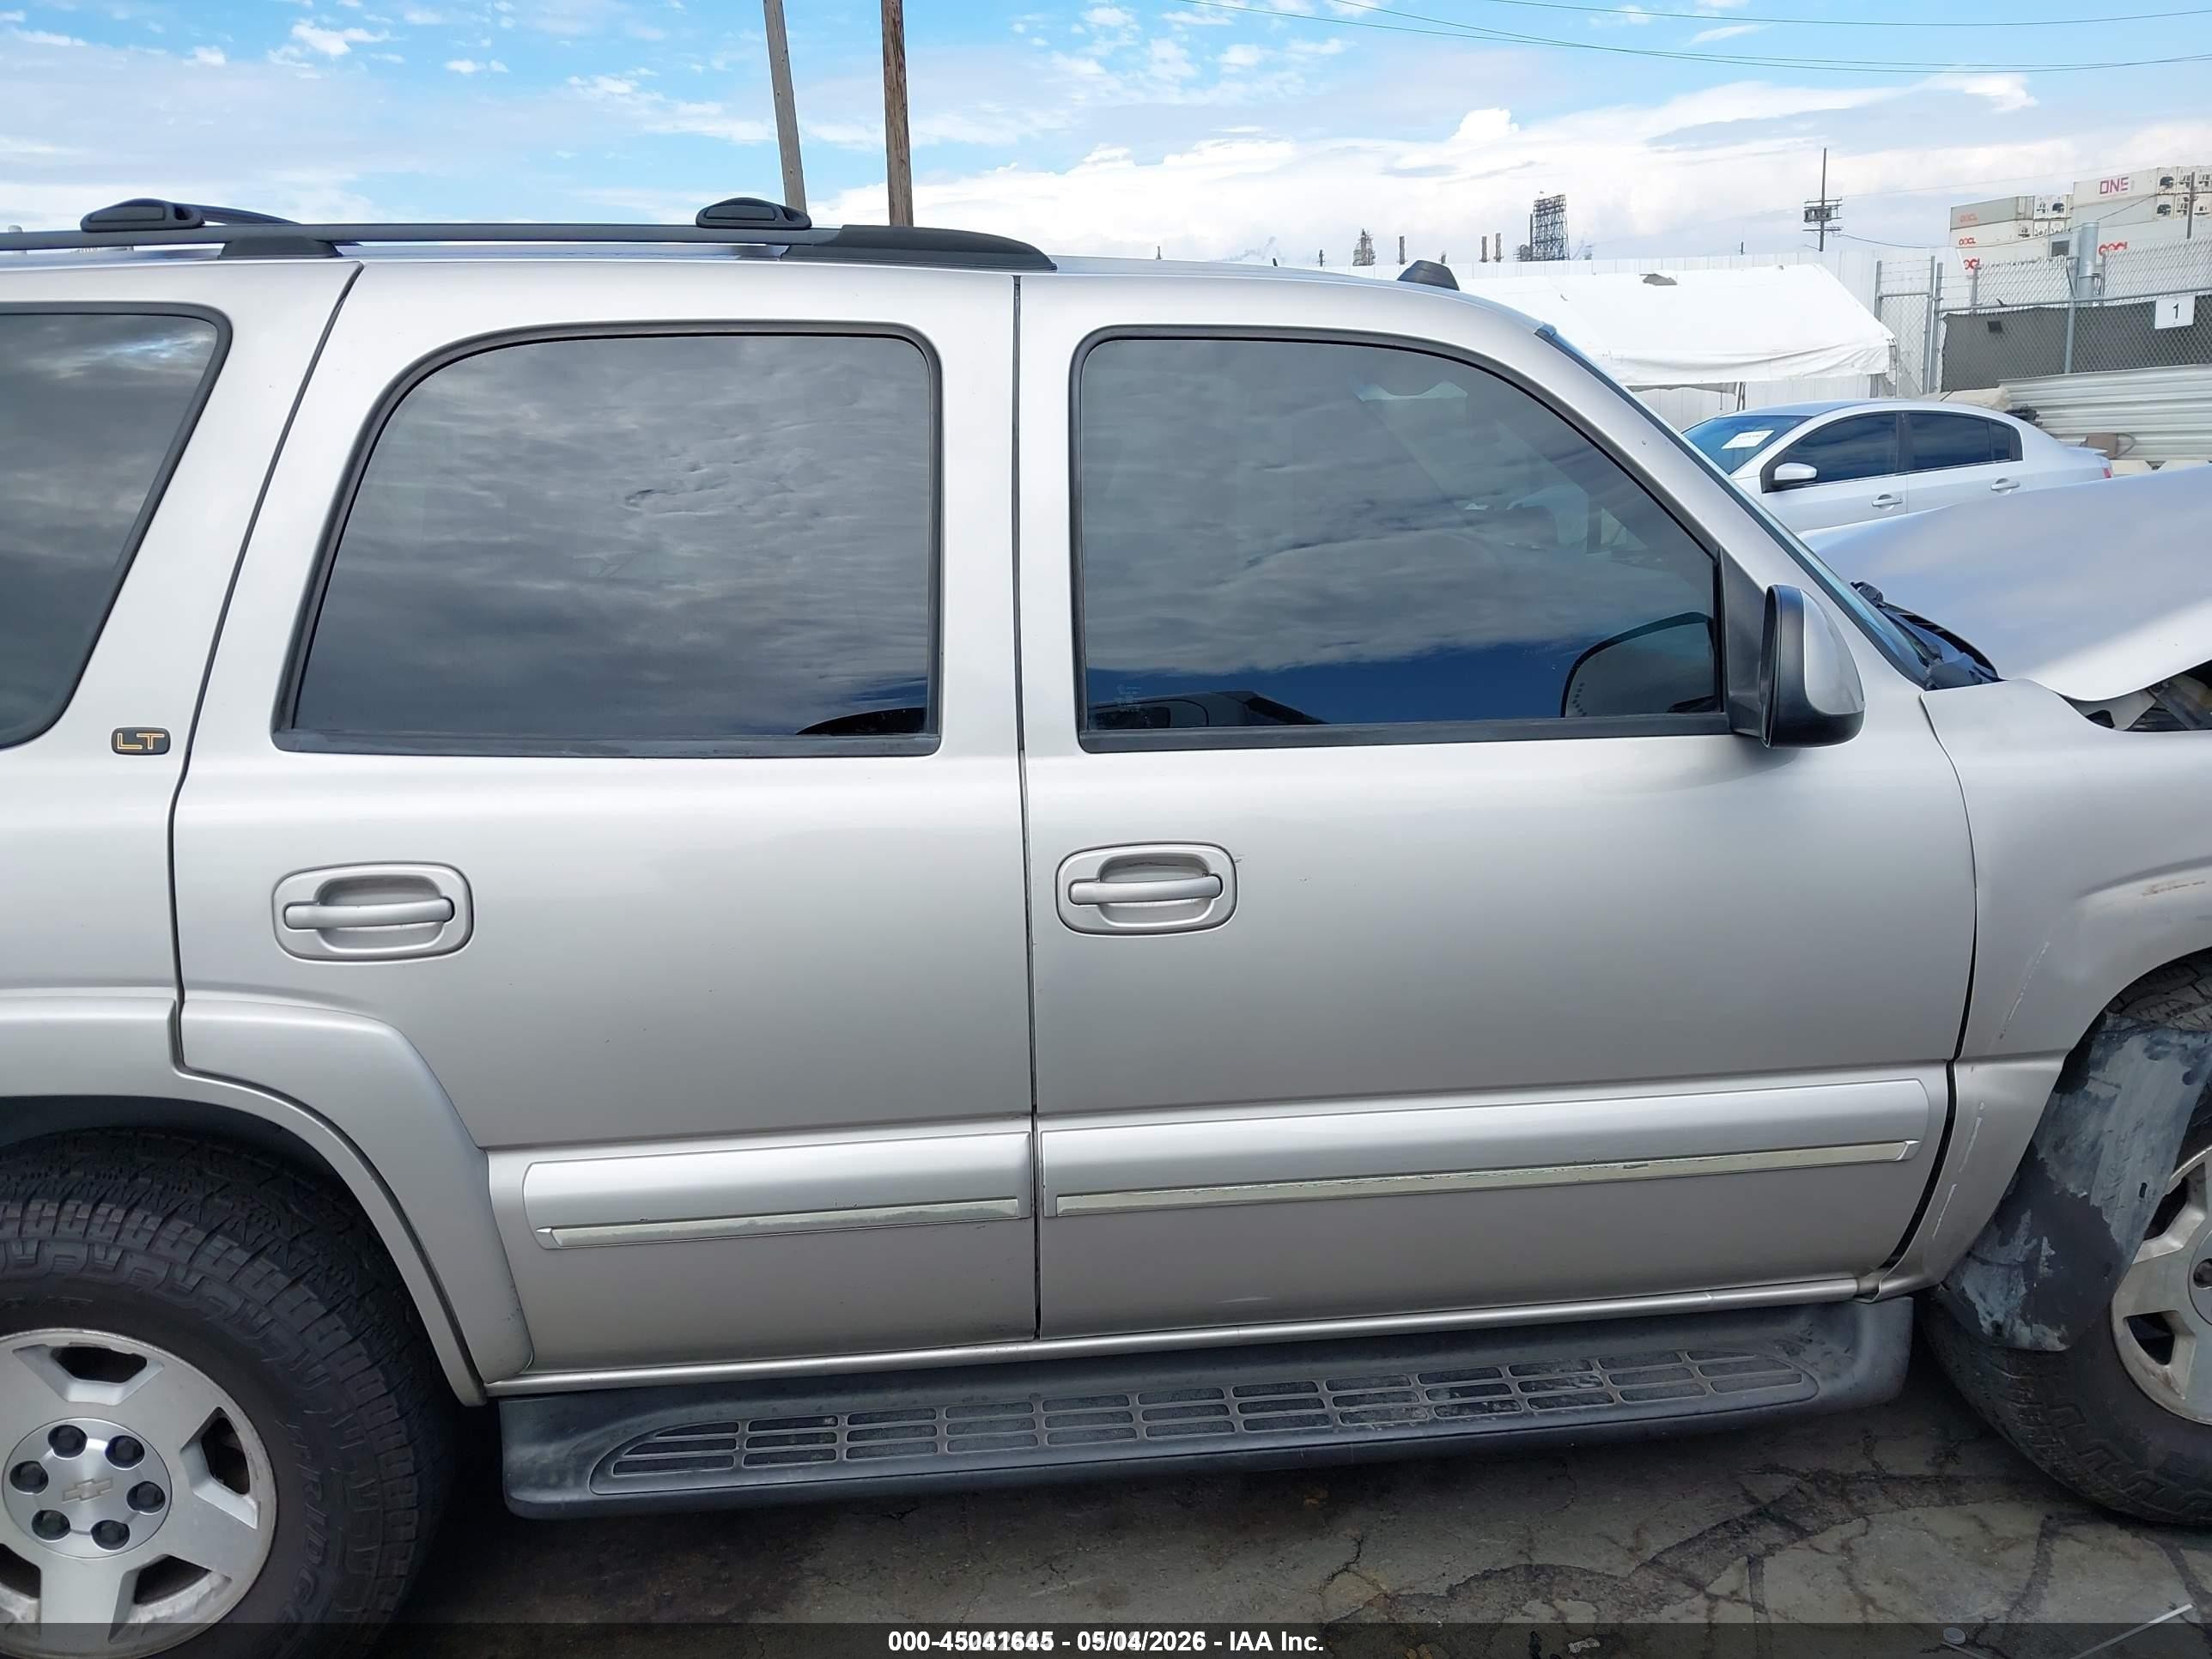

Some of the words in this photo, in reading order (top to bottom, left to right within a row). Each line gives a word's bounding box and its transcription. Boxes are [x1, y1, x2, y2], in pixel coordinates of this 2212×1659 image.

[2100, 177, 2129, 194] ONE
[1959, 237, 1977, 246] OOCL
[2172, 302, 2180, 319] 1
[117, 732, 165, 750] LT
